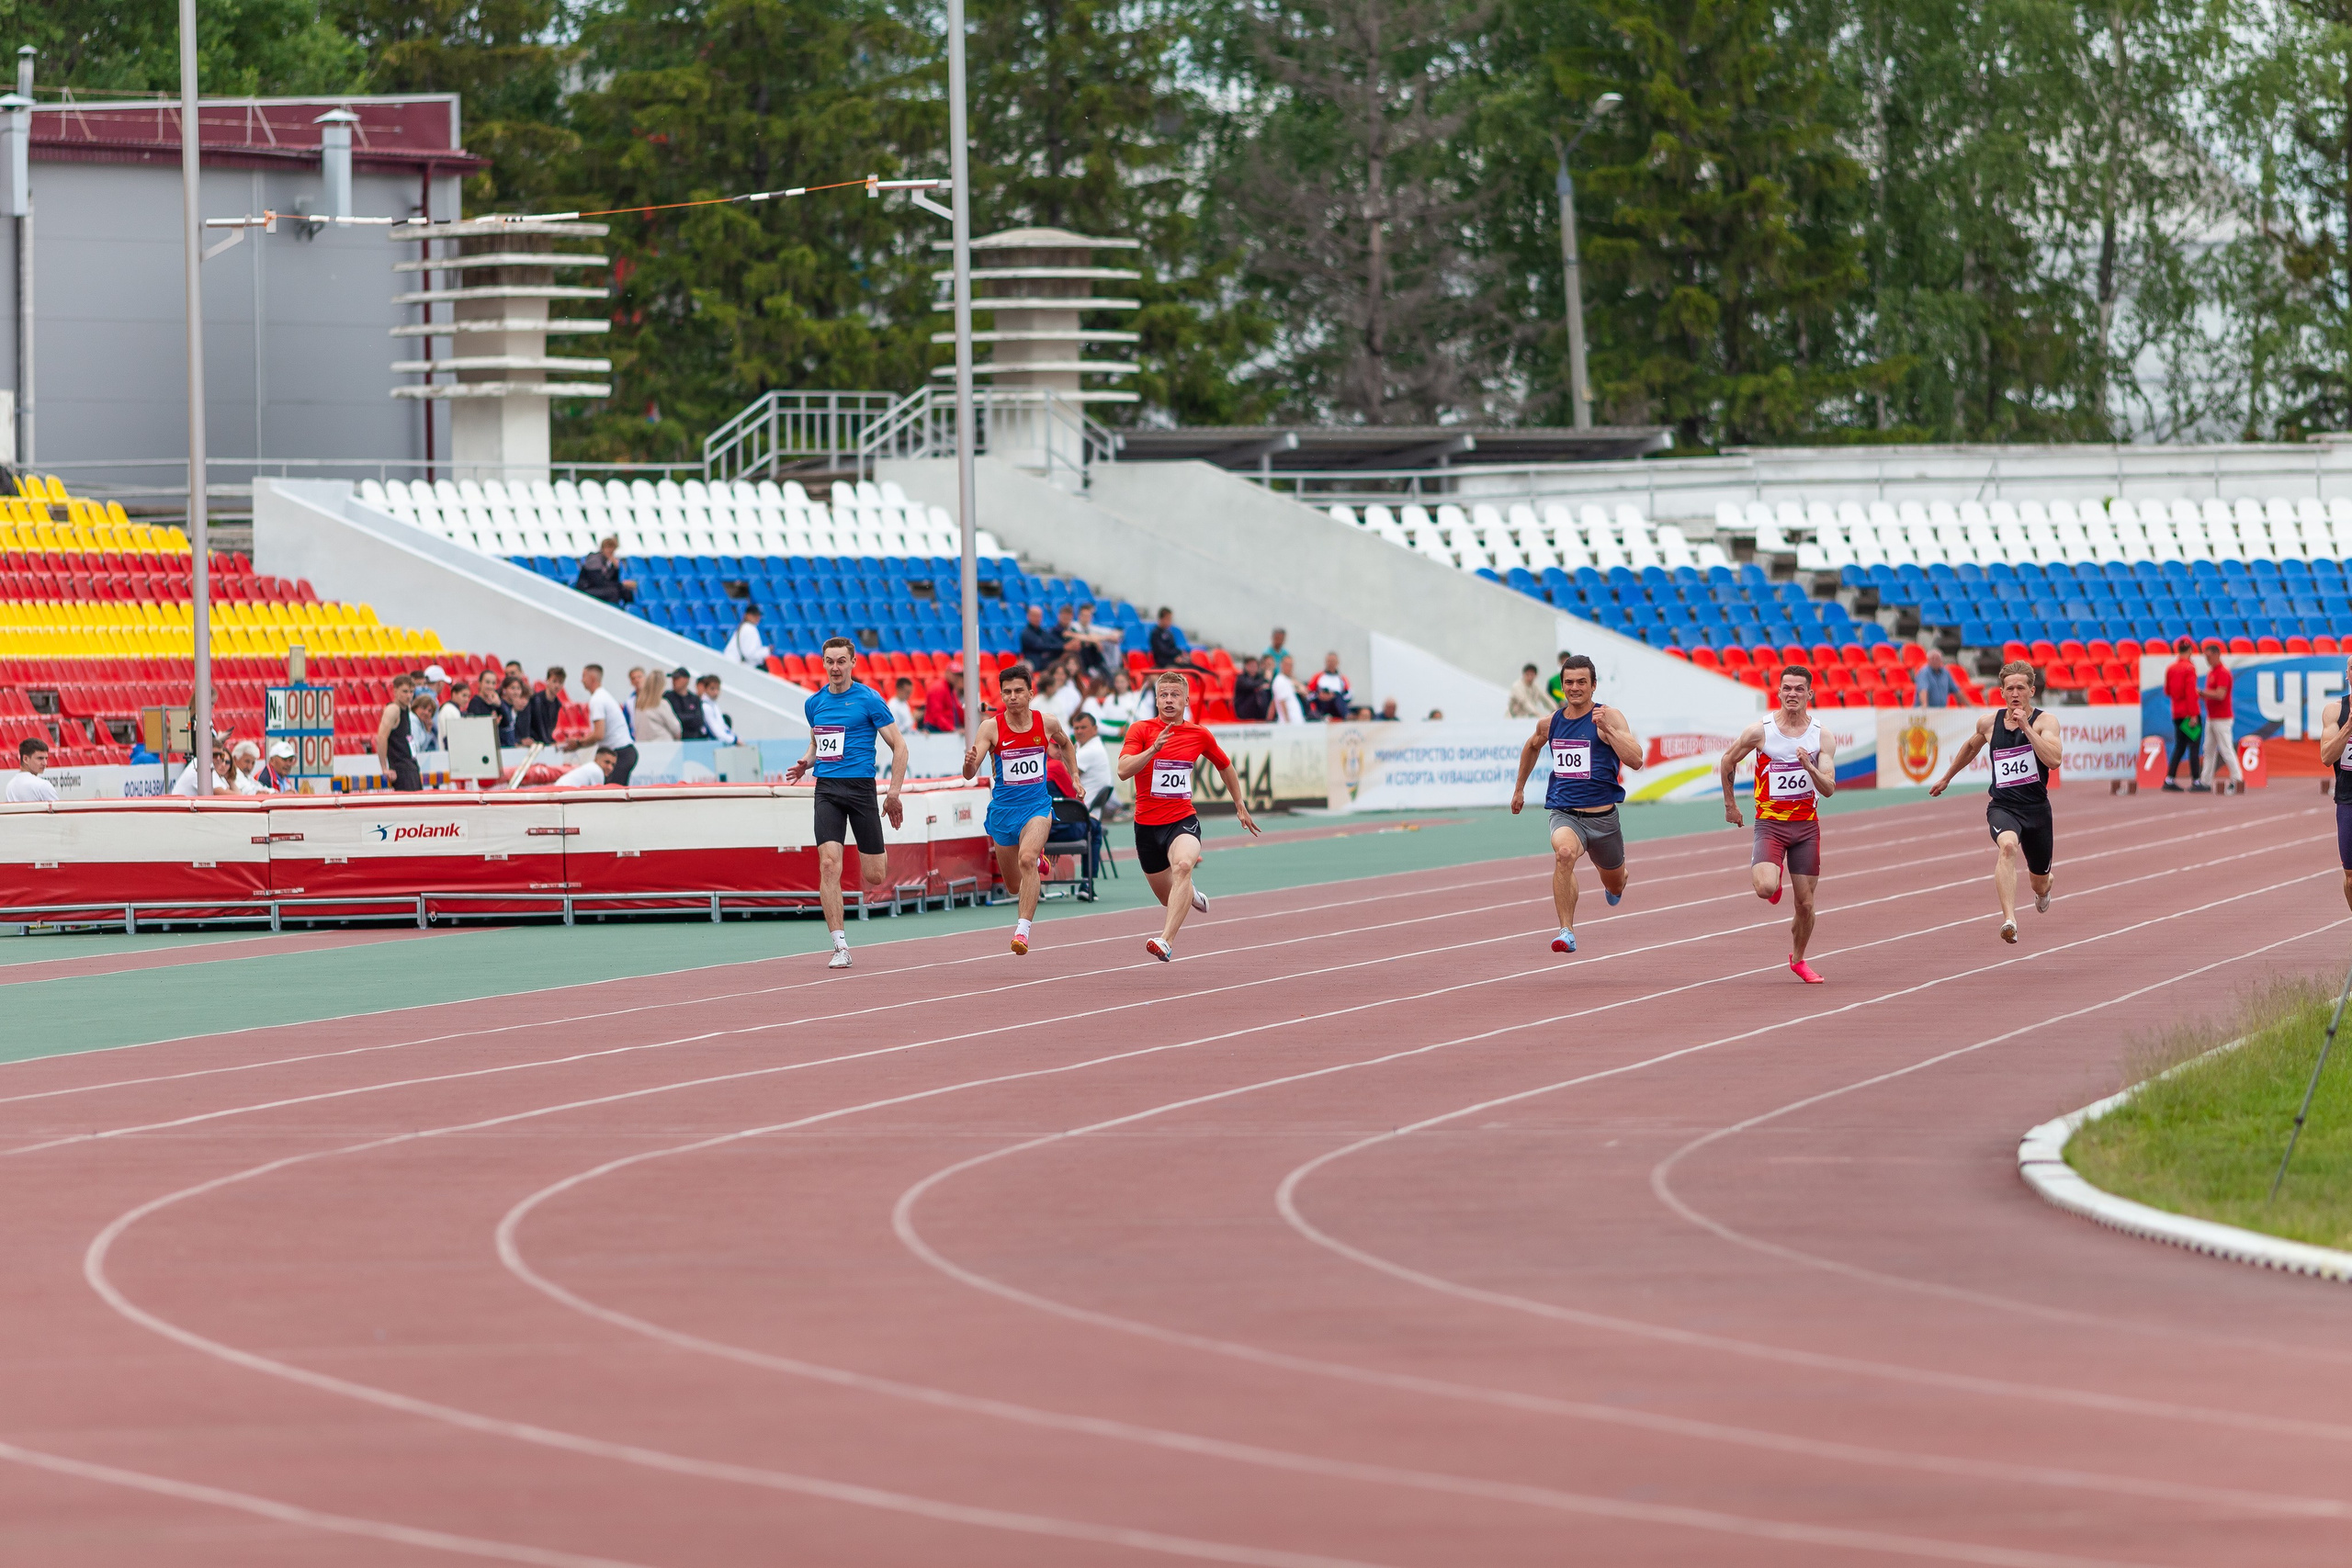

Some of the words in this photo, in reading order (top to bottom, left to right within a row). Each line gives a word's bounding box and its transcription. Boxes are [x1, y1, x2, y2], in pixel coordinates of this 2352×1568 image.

[2061, 726, 2126, 744] ТРАЦИЯ
[1375, 747, 1455, 762] МИНИСТЕРСТВО
[1459, 745, 1521, 761] ФИЗИЧЕСКО
[1556, 753, 1581, 767] 108
[2063, 751, 2137, 771] ЕСПУБЛИ
[2143, 745, 2161, 771] 7
[2243, 747, 2259, 772] 6
[1010, 760, 1038, 775] 400
[2001, 759, 2029, 776] 346
[1160, 773, 1185, 788] 204
[1777, 774, 1806, 789] 266
[393, 822, 461, 842] polanik
